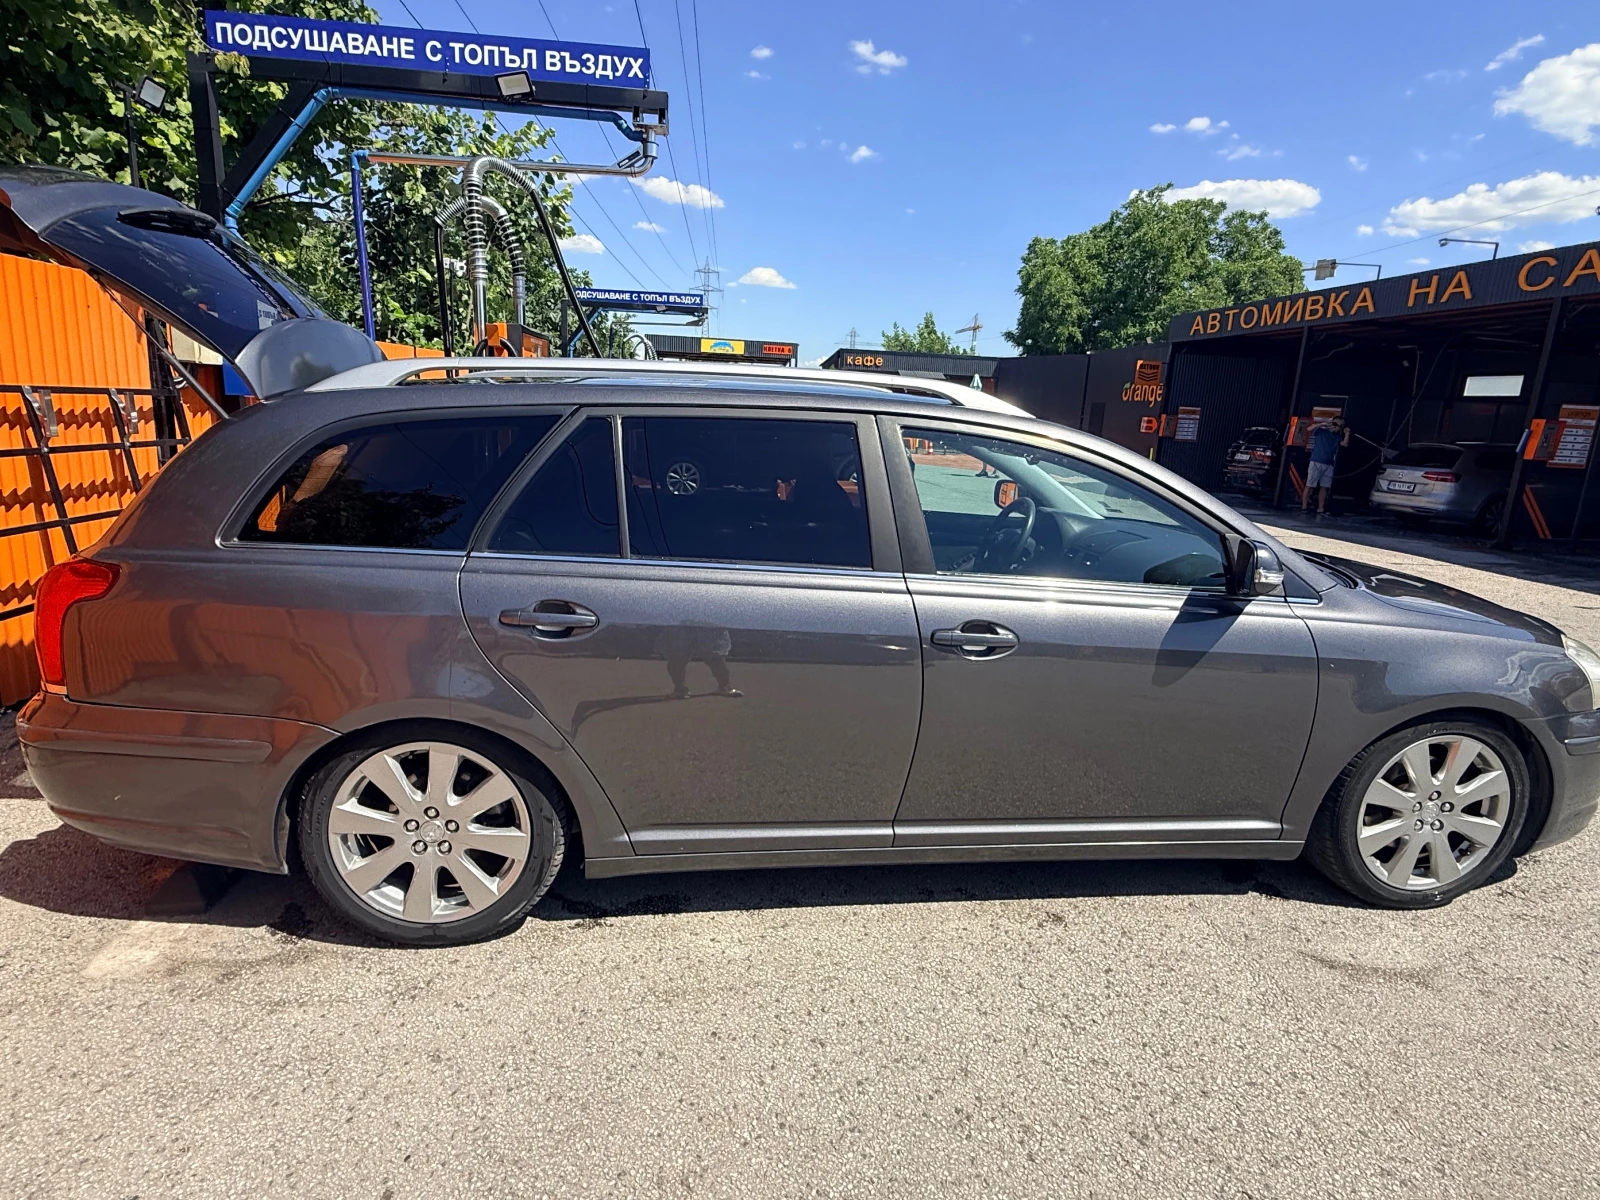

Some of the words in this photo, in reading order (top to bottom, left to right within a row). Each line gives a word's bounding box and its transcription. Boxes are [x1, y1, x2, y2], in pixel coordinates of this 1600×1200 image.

[215, 22, 415, 60] ПОДСУШАВАНЕ
[425, 40, 443, 62] С
[449, 42, 537, 70] ТОПЪЛ
[545, 50, 645, 80] ВЪЗДУХ
[575, 290, 630, 300] ОДСУШАВАНЕ
[632, 293, 638, 301] С
[640, 293, 667, 302] ТОПЪЛ
[669, 295, 700, 304] ВЪЗДУХ
[1189, 286, 1375, 336] АВТОМИВКА
[1407, 270, 1472, 307] НА
[846, 355, 883, 368] кафе
[1122, 383, 1163, 407] orange
